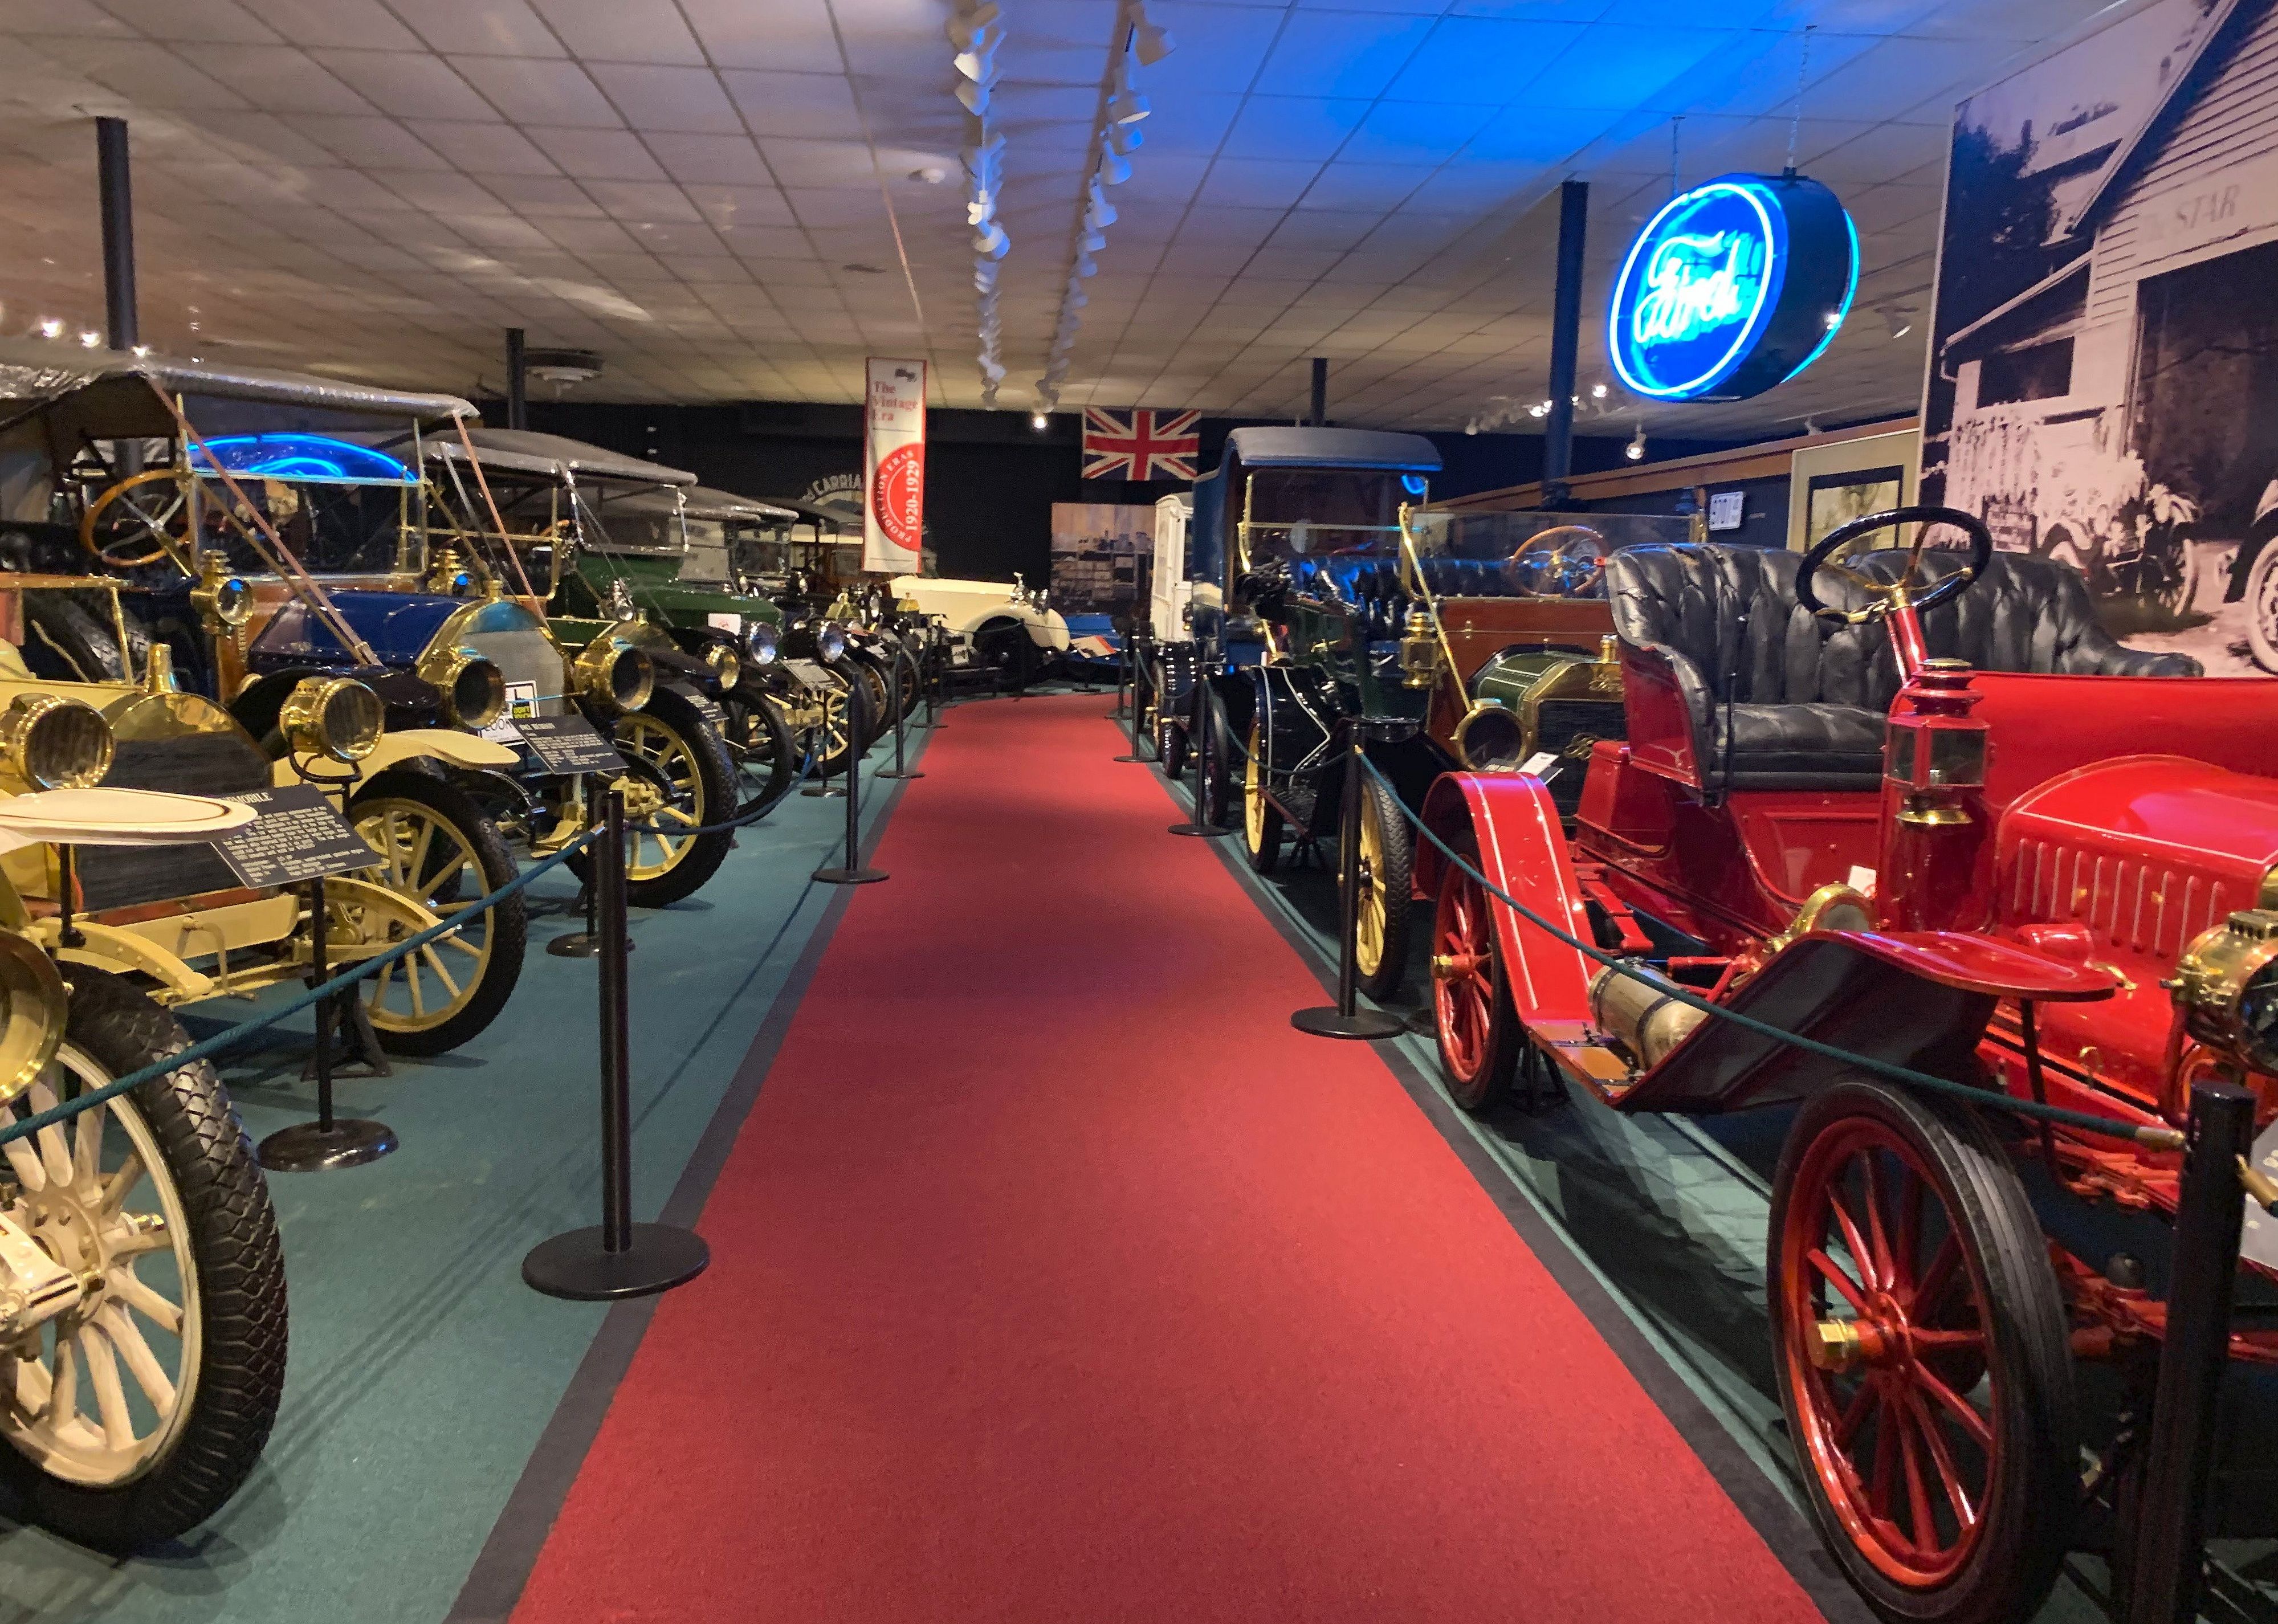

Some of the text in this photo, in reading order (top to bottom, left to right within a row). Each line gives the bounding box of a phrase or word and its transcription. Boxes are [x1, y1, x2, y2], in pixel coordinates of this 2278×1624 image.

[2175, 184, 2241, 228] STAR
[1633, 230, 1742, 344] Ford
[875, 381, 895, 394] The
[873, 410, 894, 422] ra
[812, 473, 862, 496] CARRIA
[905, 459, 920, 531] 1920-1929
